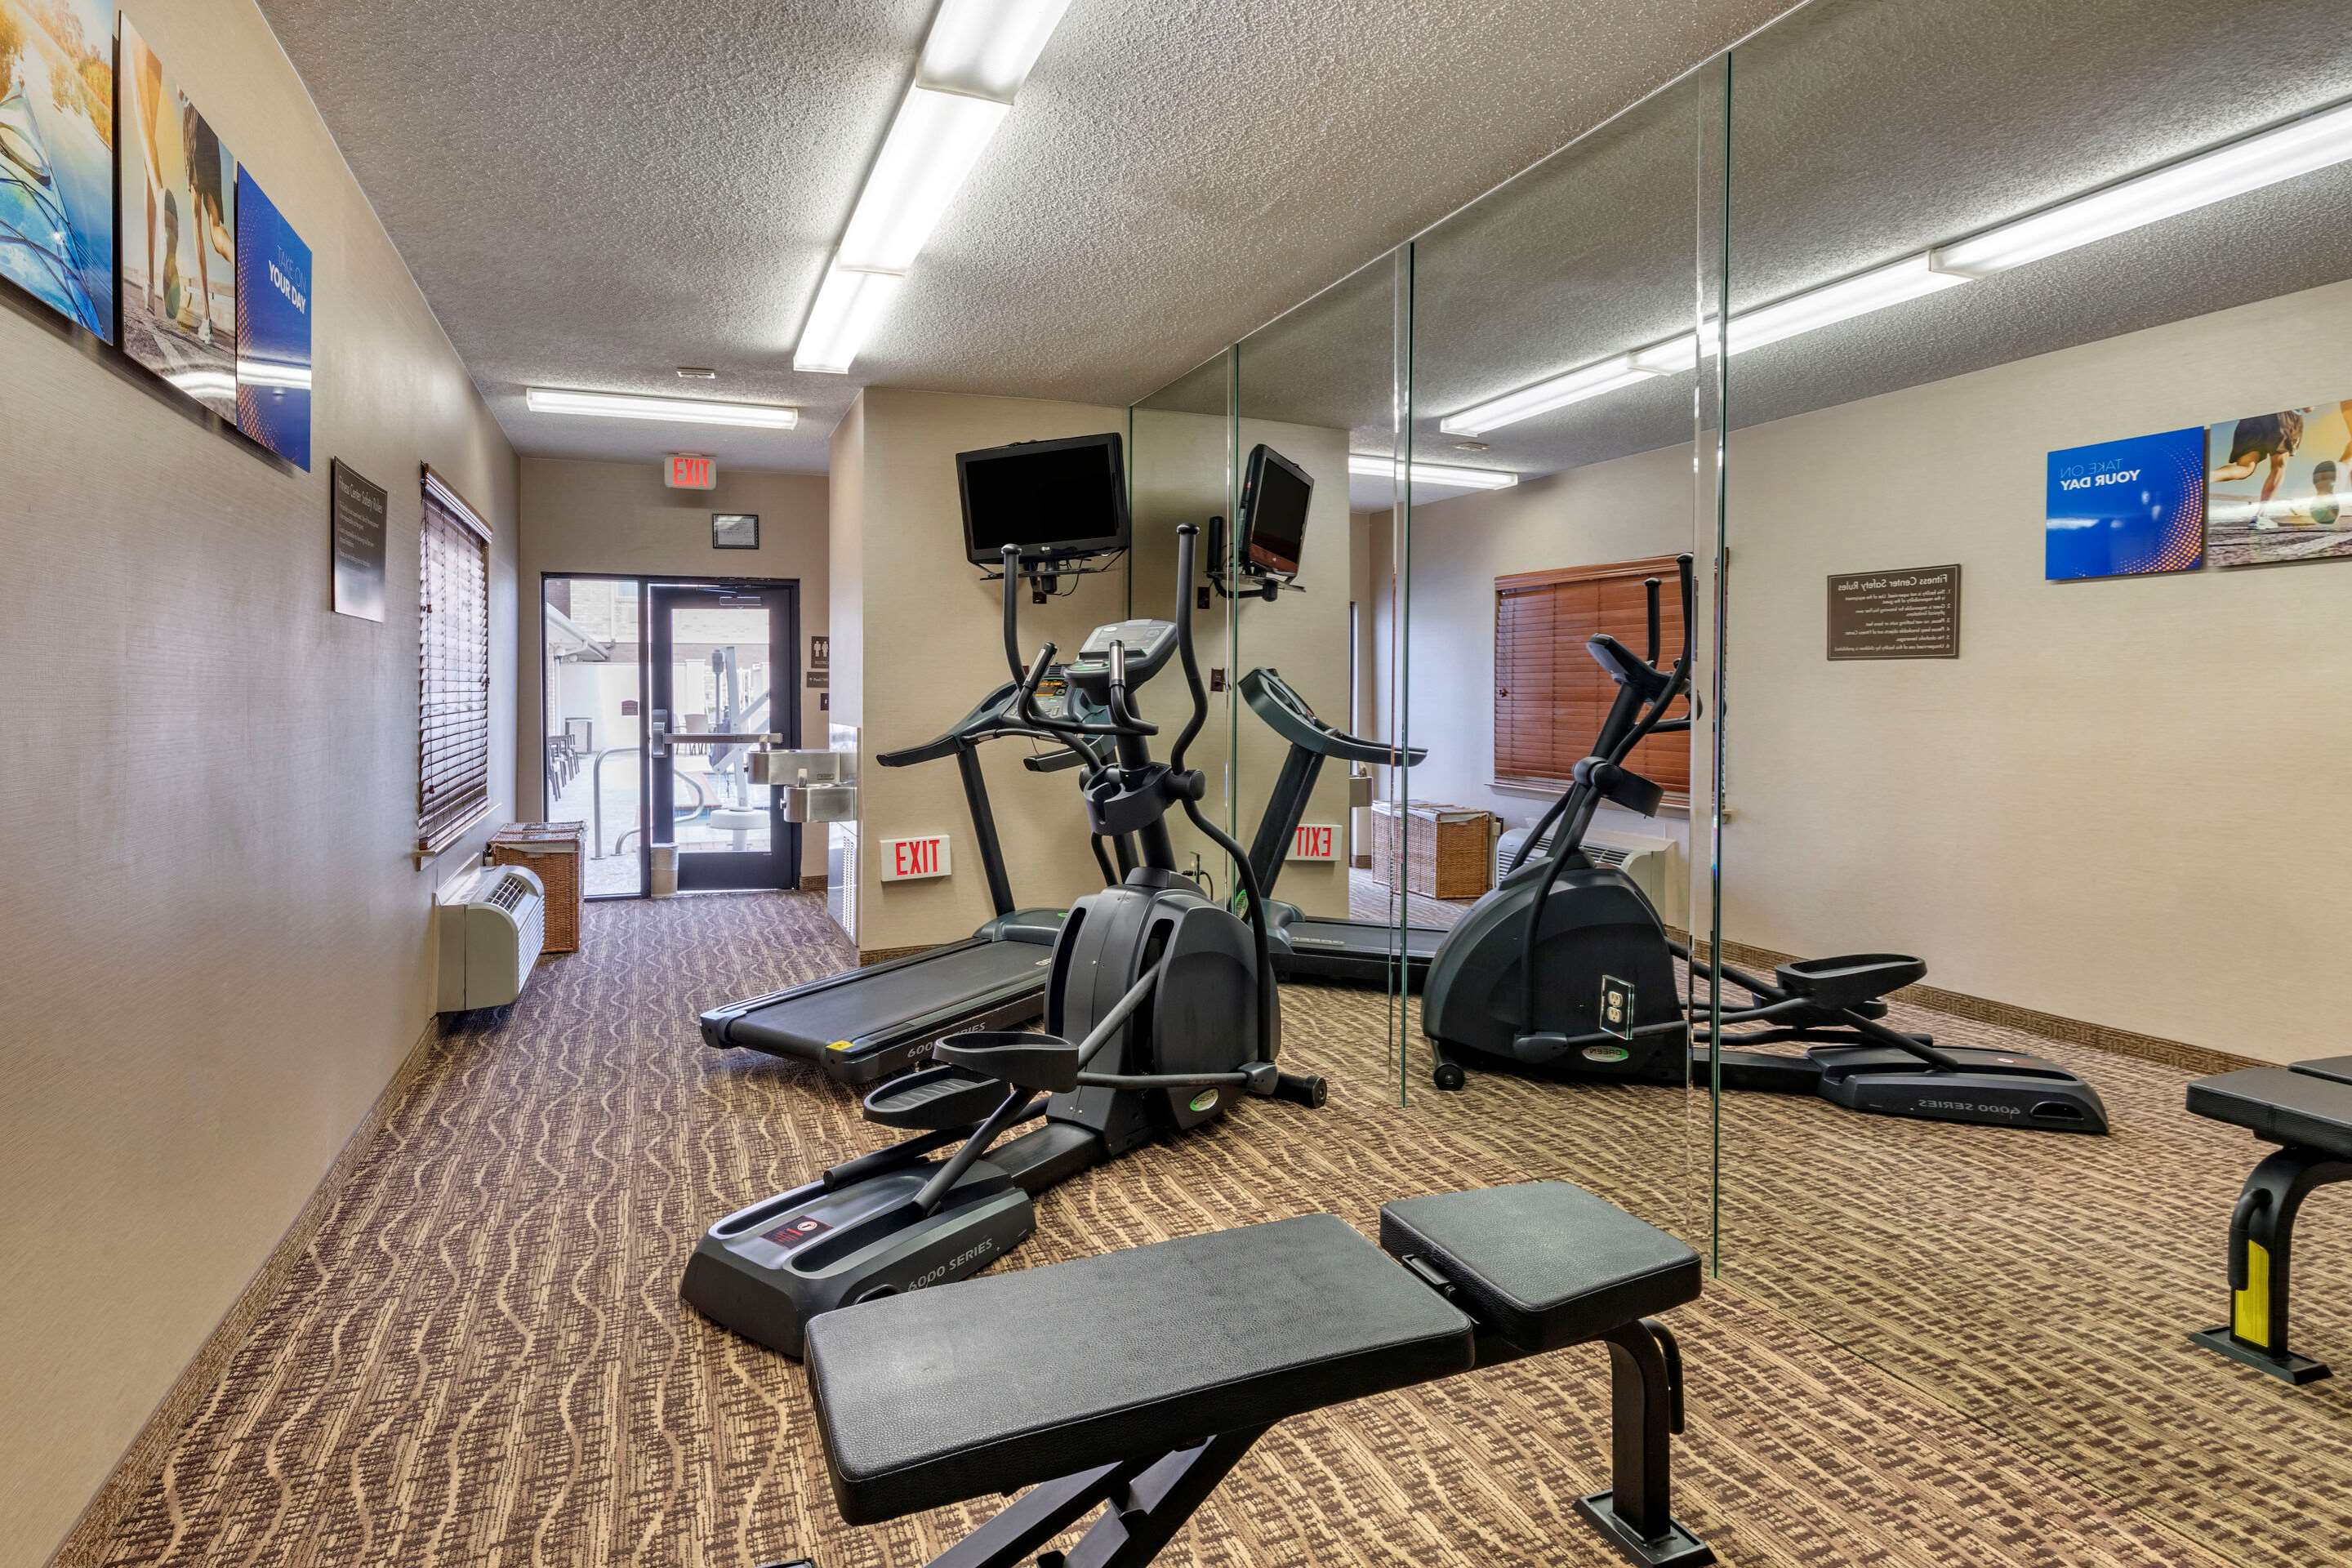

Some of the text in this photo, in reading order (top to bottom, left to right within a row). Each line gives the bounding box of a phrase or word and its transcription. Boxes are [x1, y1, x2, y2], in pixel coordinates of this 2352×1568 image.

[268, 259, 306, 314] YOUR DAY
[277, 244, 306, 295] TAKE ON
[673, 457, 710, 487] EXIT
[895, 840, 940, 876] EXIT
[906, 1237, 994, 1293] 6000 SERIES
